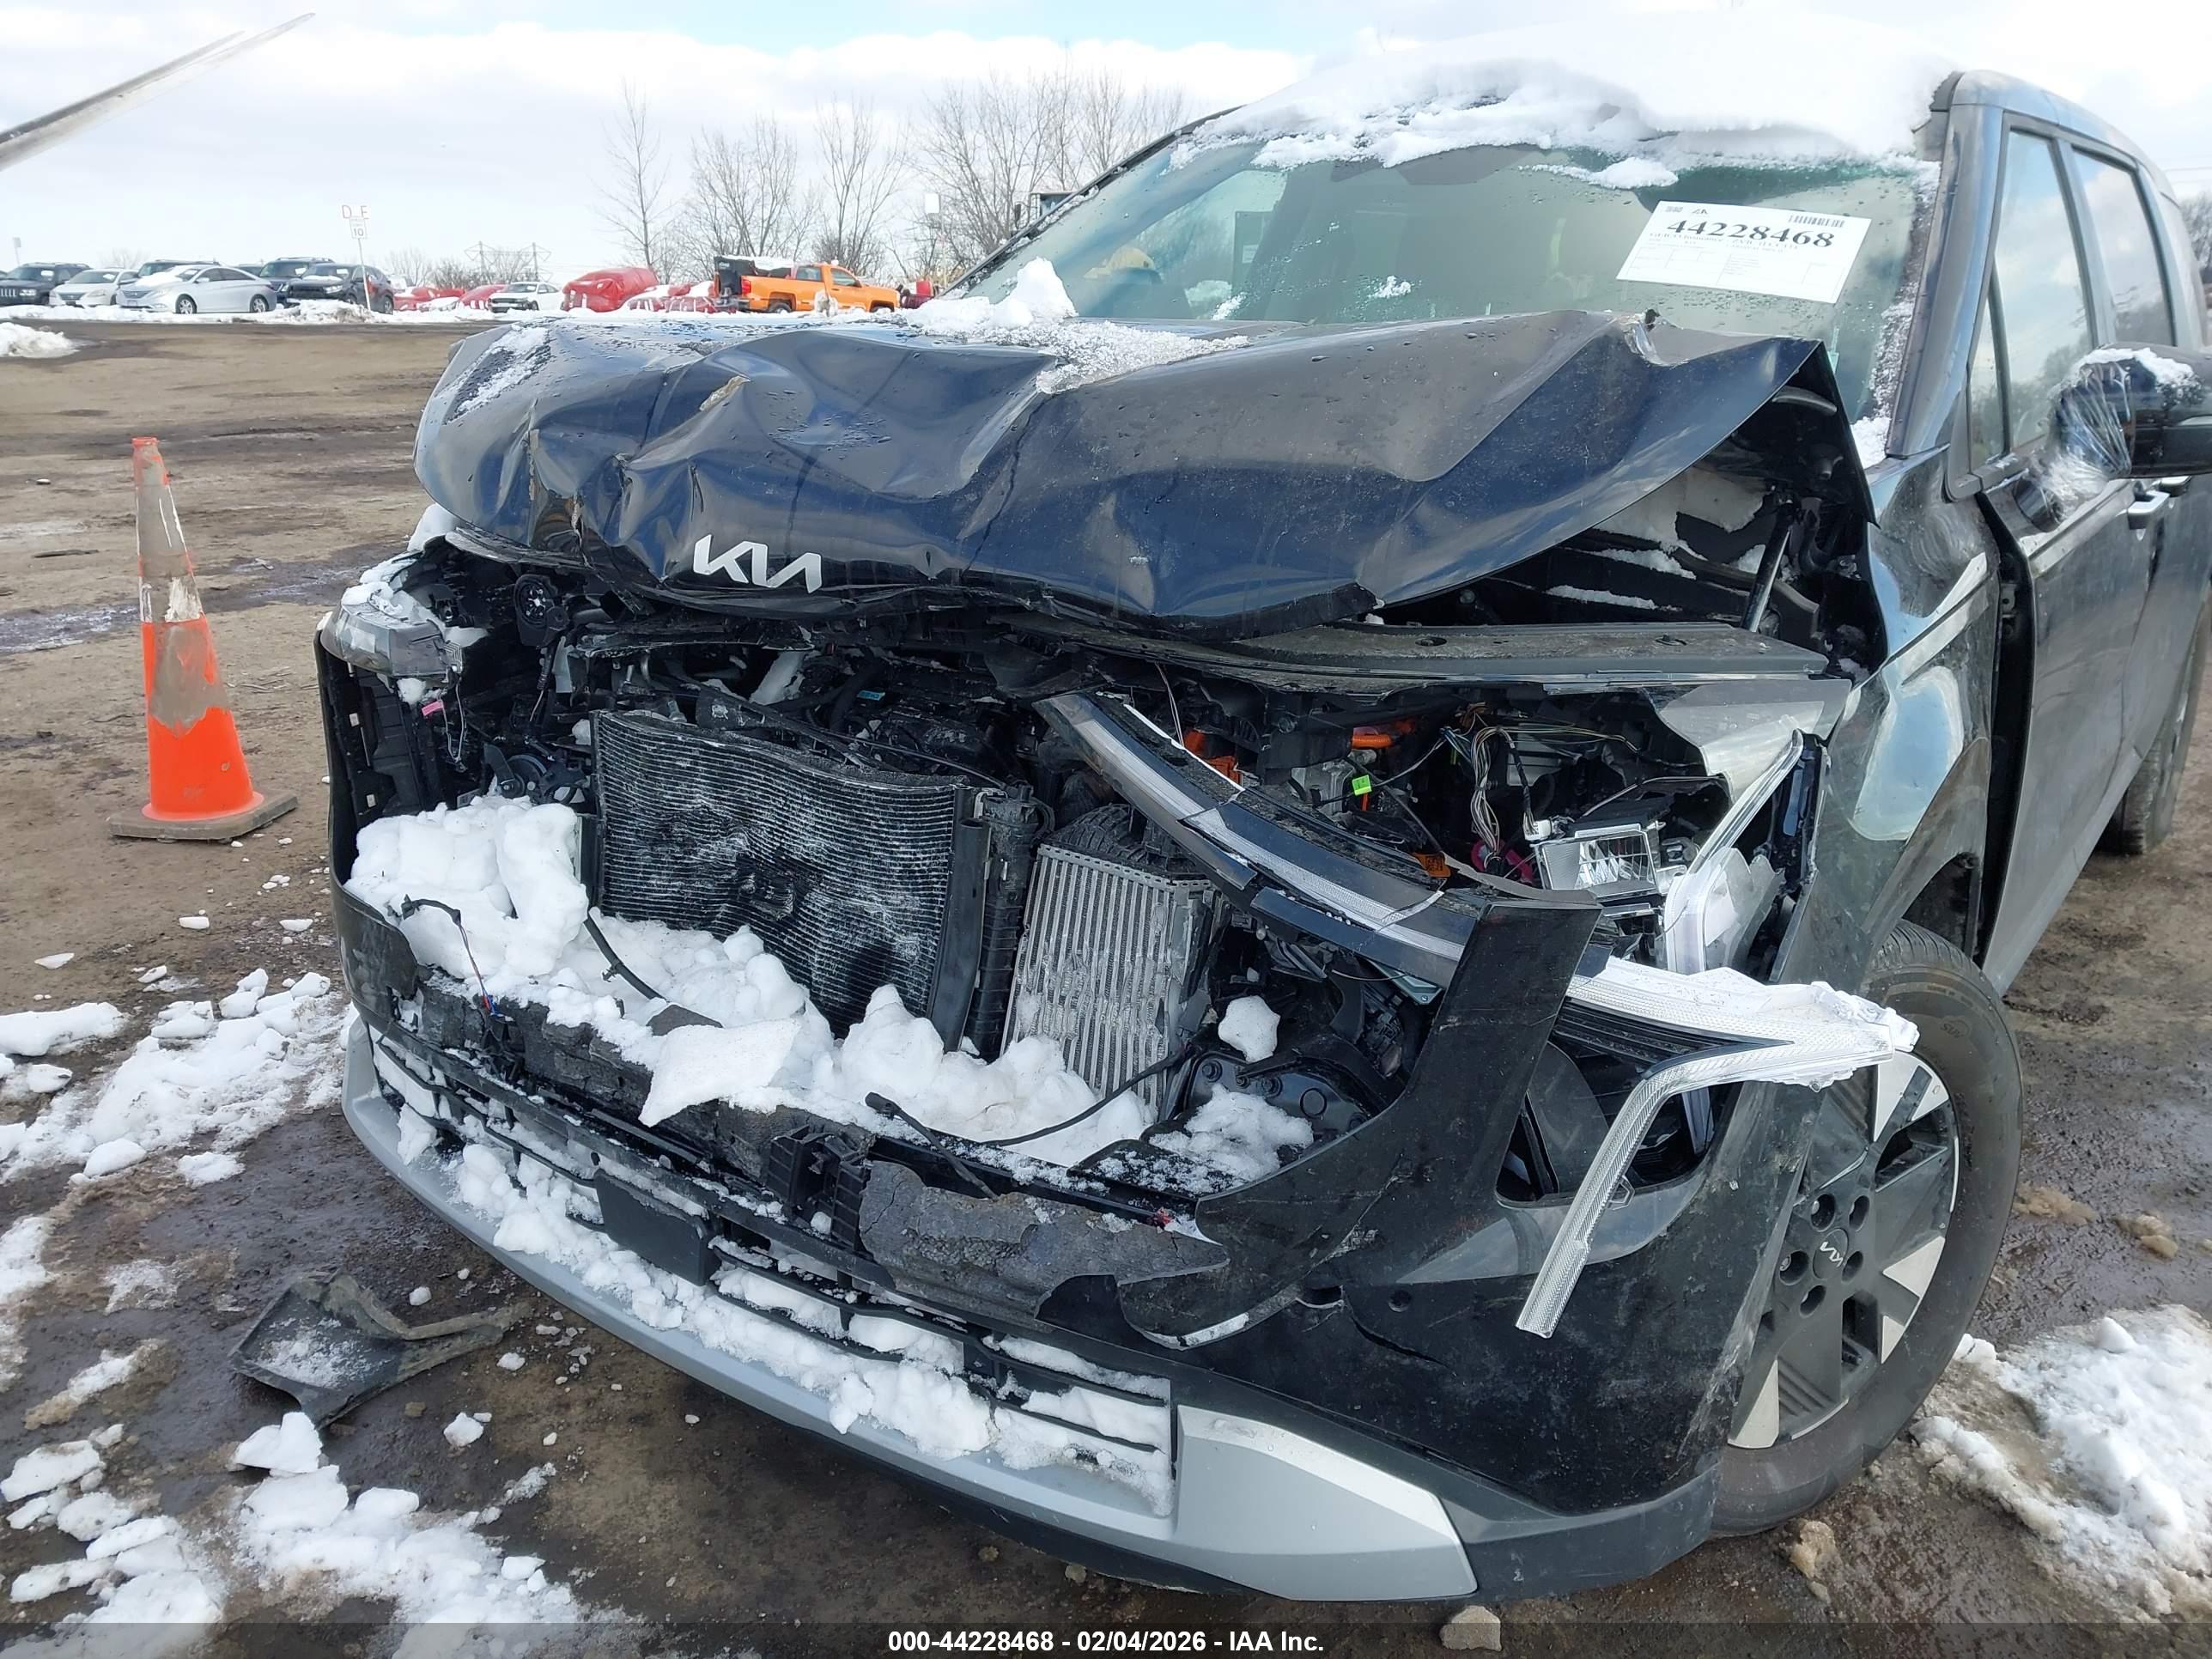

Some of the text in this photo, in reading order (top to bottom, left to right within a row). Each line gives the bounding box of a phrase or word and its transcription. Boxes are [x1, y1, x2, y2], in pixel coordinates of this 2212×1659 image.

[353, 228, 364, 237] 10
[1667, 220, 1835, 248] 44228468
[693, 534, 823, 594] KIA
